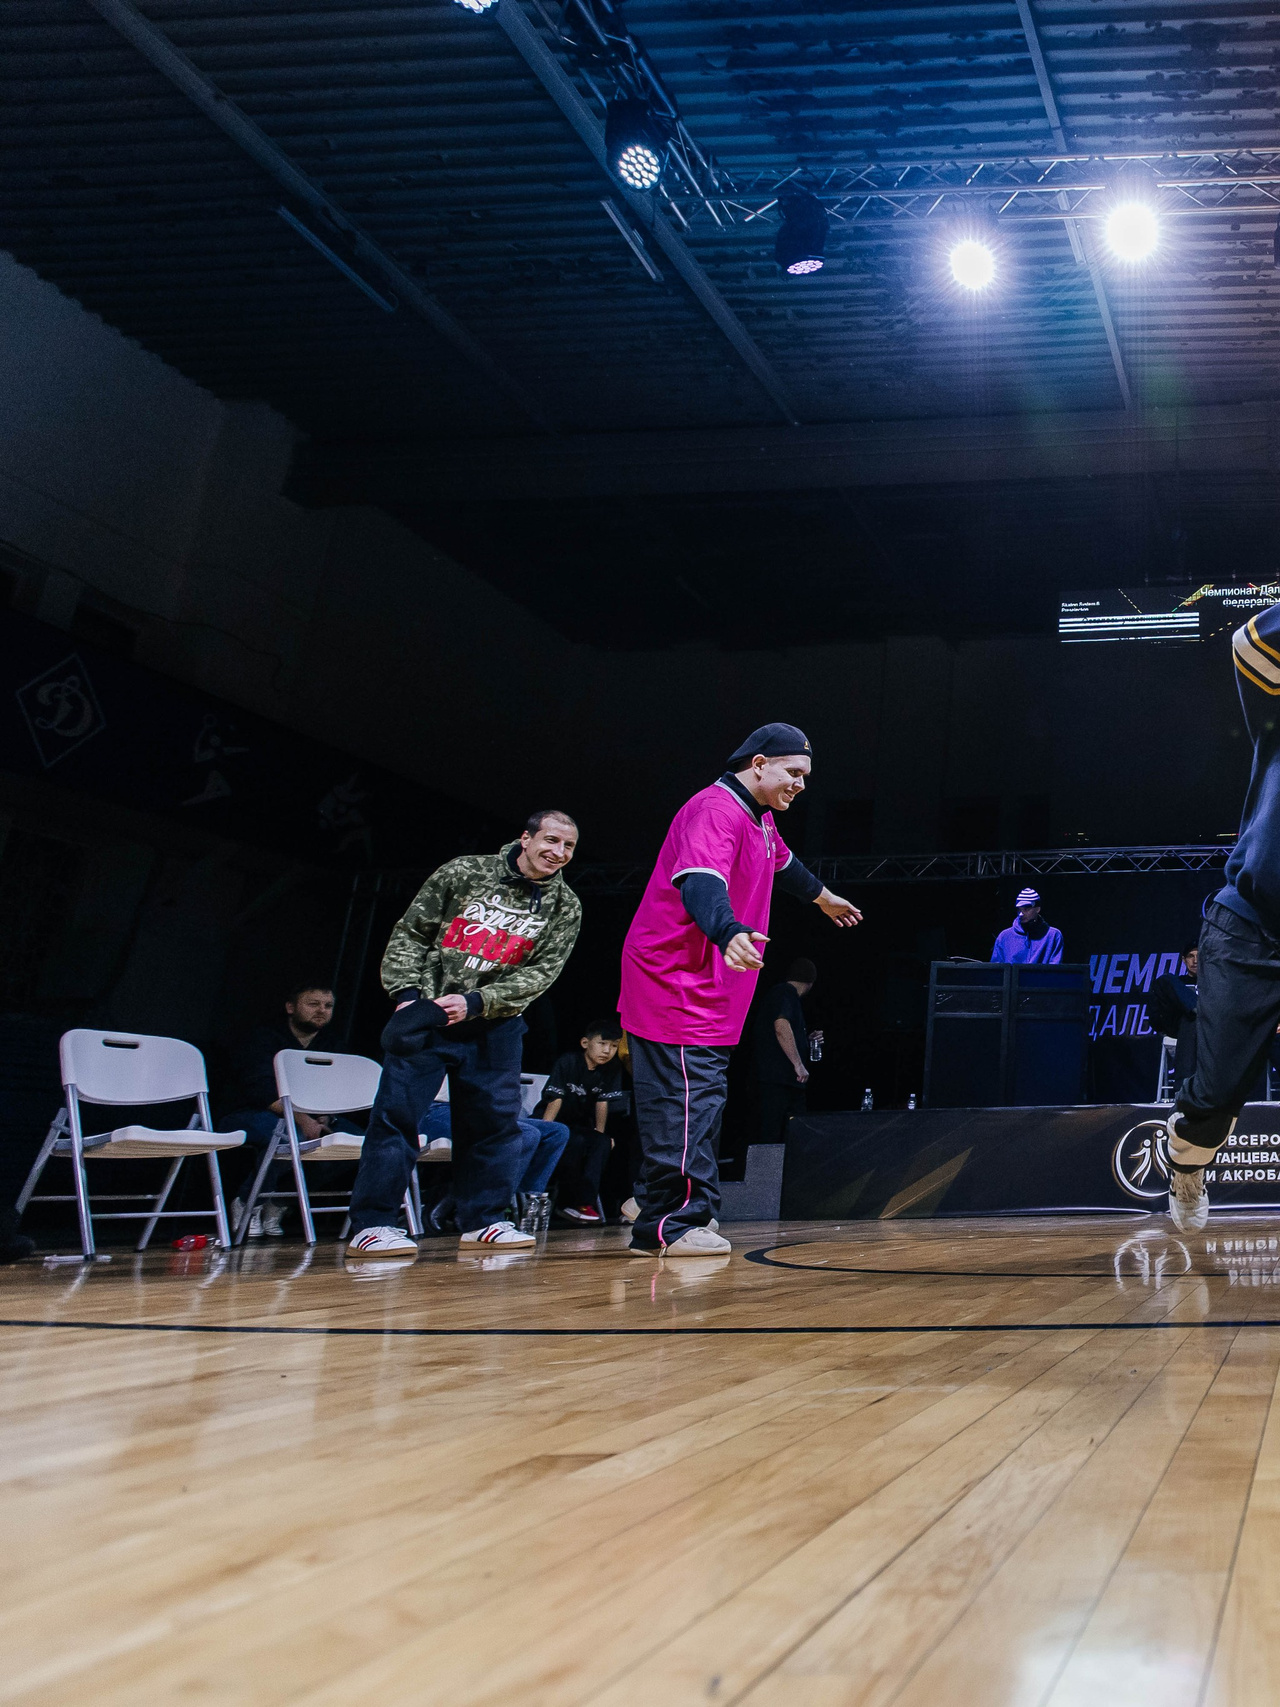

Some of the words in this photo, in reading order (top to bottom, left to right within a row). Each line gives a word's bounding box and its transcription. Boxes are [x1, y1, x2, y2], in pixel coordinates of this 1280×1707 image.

[1200, 586, 1258, 597] Чемпионат
[464, 955, 481, 969] IN
[1089, 952, 1189, 994] ЧЕМП
[1088, 1003, 1157, 1041] ДАЛЬ
[1206, 1169, 1217, 1182] И
